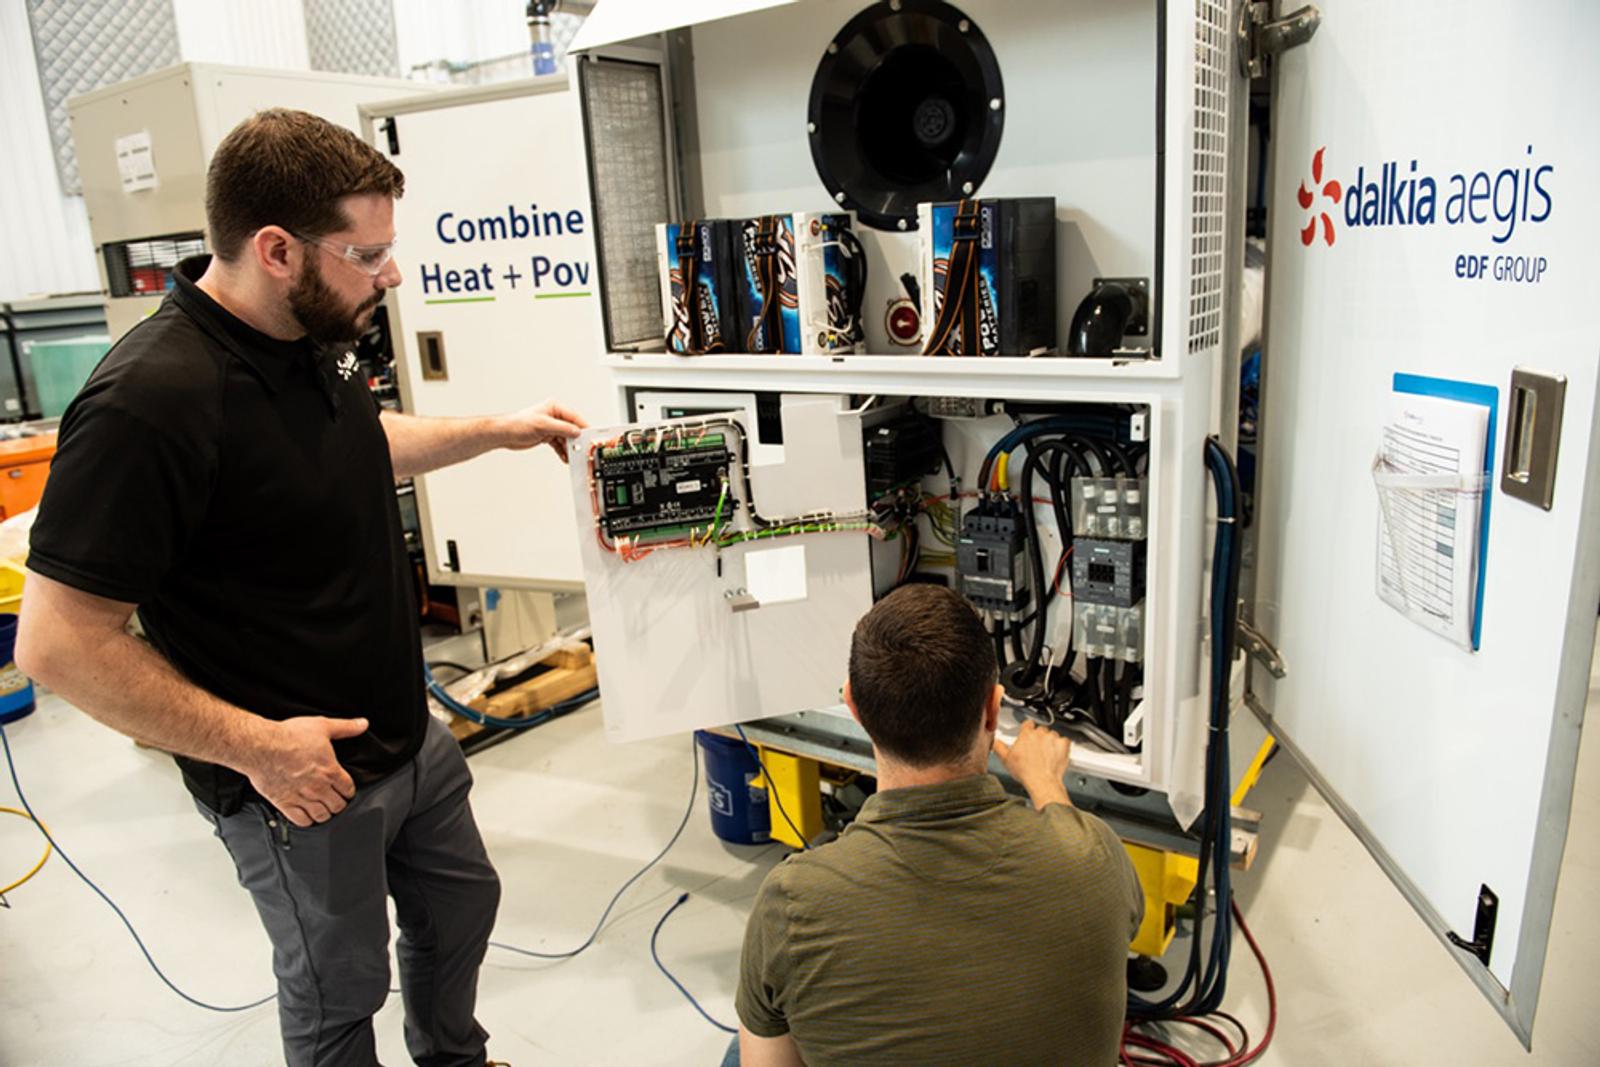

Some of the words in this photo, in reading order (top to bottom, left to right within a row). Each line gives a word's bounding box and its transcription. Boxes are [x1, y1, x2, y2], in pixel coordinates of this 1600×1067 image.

[1344, 159, 1437, 227] dalkia
[1445, 144, 1554, 243] aegis
[420, 262, 494, 294] Heat
[1493, 255, 1547, 283] GROUP
